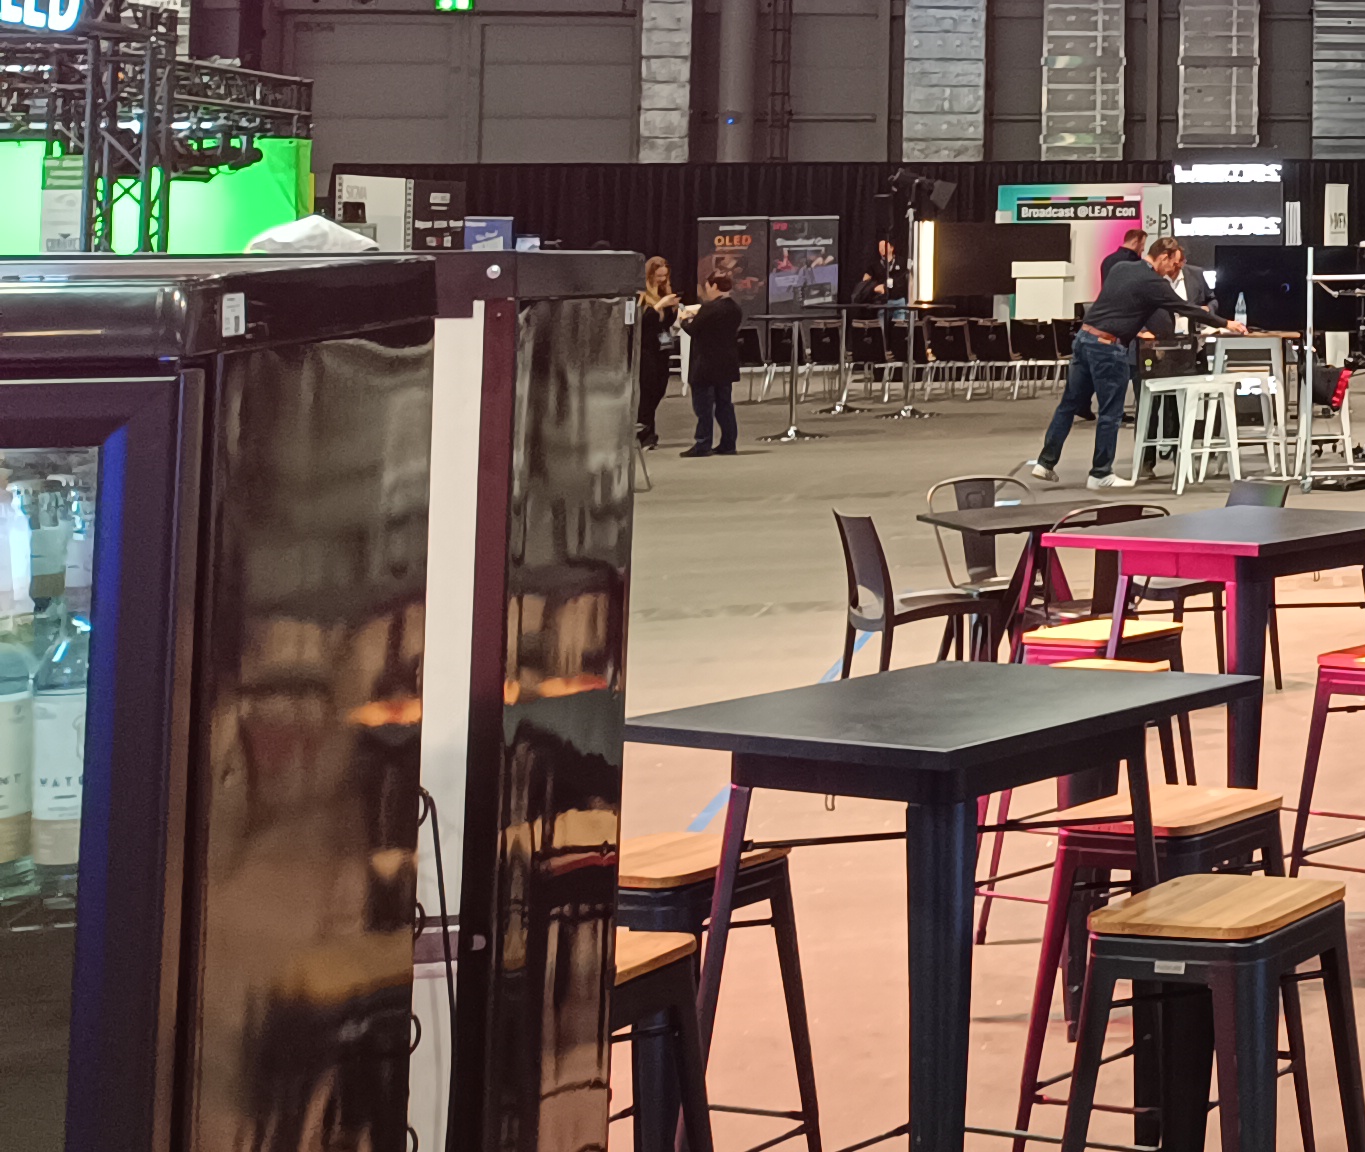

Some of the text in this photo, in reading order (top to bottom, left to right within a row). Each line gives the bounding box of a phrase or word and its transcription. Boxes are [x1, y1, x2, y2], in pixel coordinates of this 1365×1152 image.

[1021, 206, 1075, 218] Broadcast
[1115, 205, 1136, 217] con
[714, 235, 752, 246] OLED
